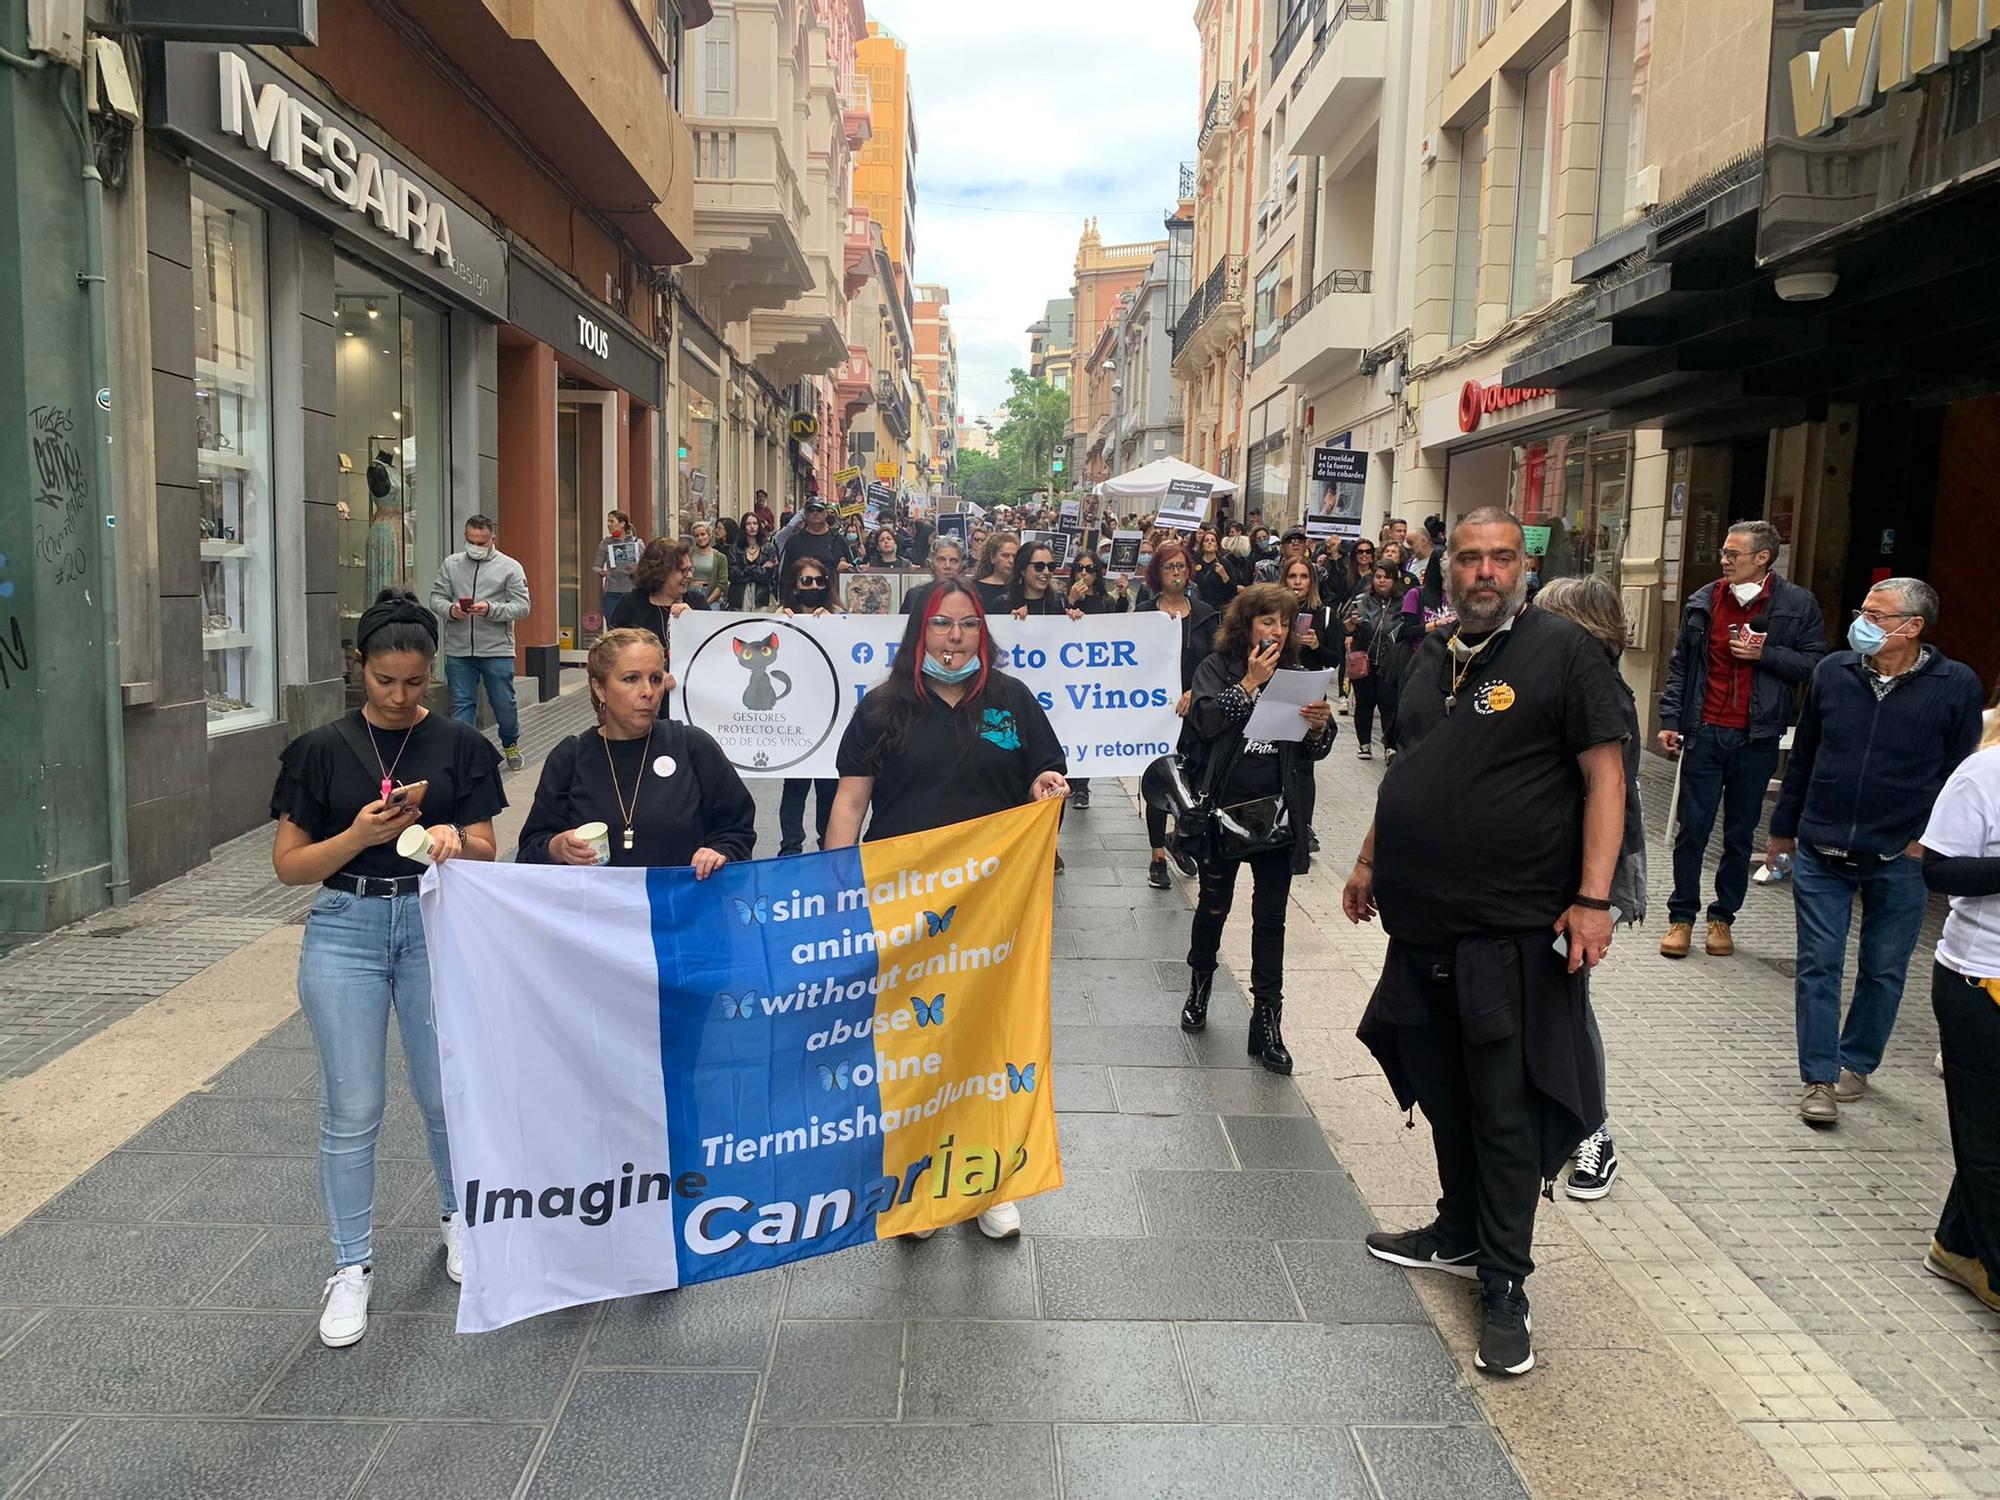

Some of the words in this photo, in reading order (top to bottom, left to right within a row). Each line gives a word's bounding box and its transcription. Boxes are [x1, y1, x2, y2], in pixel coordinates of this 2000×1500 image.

[219, 51, 453, 268] MESAIRA
[452, 256, 489, 296] design
[577, 314, 608, 359] TOUS
[1317, 468, 1326, 476] de
[1327, 468, 1336, 477] los
[1337, 470, 1364, 479] cobardes
[1319, 453, 1326, 461] La
[1328, 454, 1355, 463] crueldad
[1327, 461, 1333, 469] la
[1333, 461, 1353, 470] fuerza
[1060, 641, 1138, 668] CER
[1065, 683, 1168, 709] Vinos
[718, 725, 774, 735] PROYECTO
[776, 725, 804, 736] C.E.R.
[733, 712, 787, 722] GESTORES
[740, 736, 753, 747] DE
[756, 737, 777, 748] LOS
[780, 738, 813, 749] VINOS
[1077, 744, 1088, 762] y
[1095, 741, 1170, 758] retorno
[773, 889, 825, 923] sin
[837, 855, 1001, 913] maltrato
[791, 912, 923, 965] animal
[760, 963, 901, 1016] without
[905, 928, 1018, 982] animal
[806, 1007, 911, 1052] abuse
[852, 1051, 942, 1087] ohne
[702, 1071, 1007, 1167] Tiermisshandlung
[465, 1162, 708, 1229] Imagine
